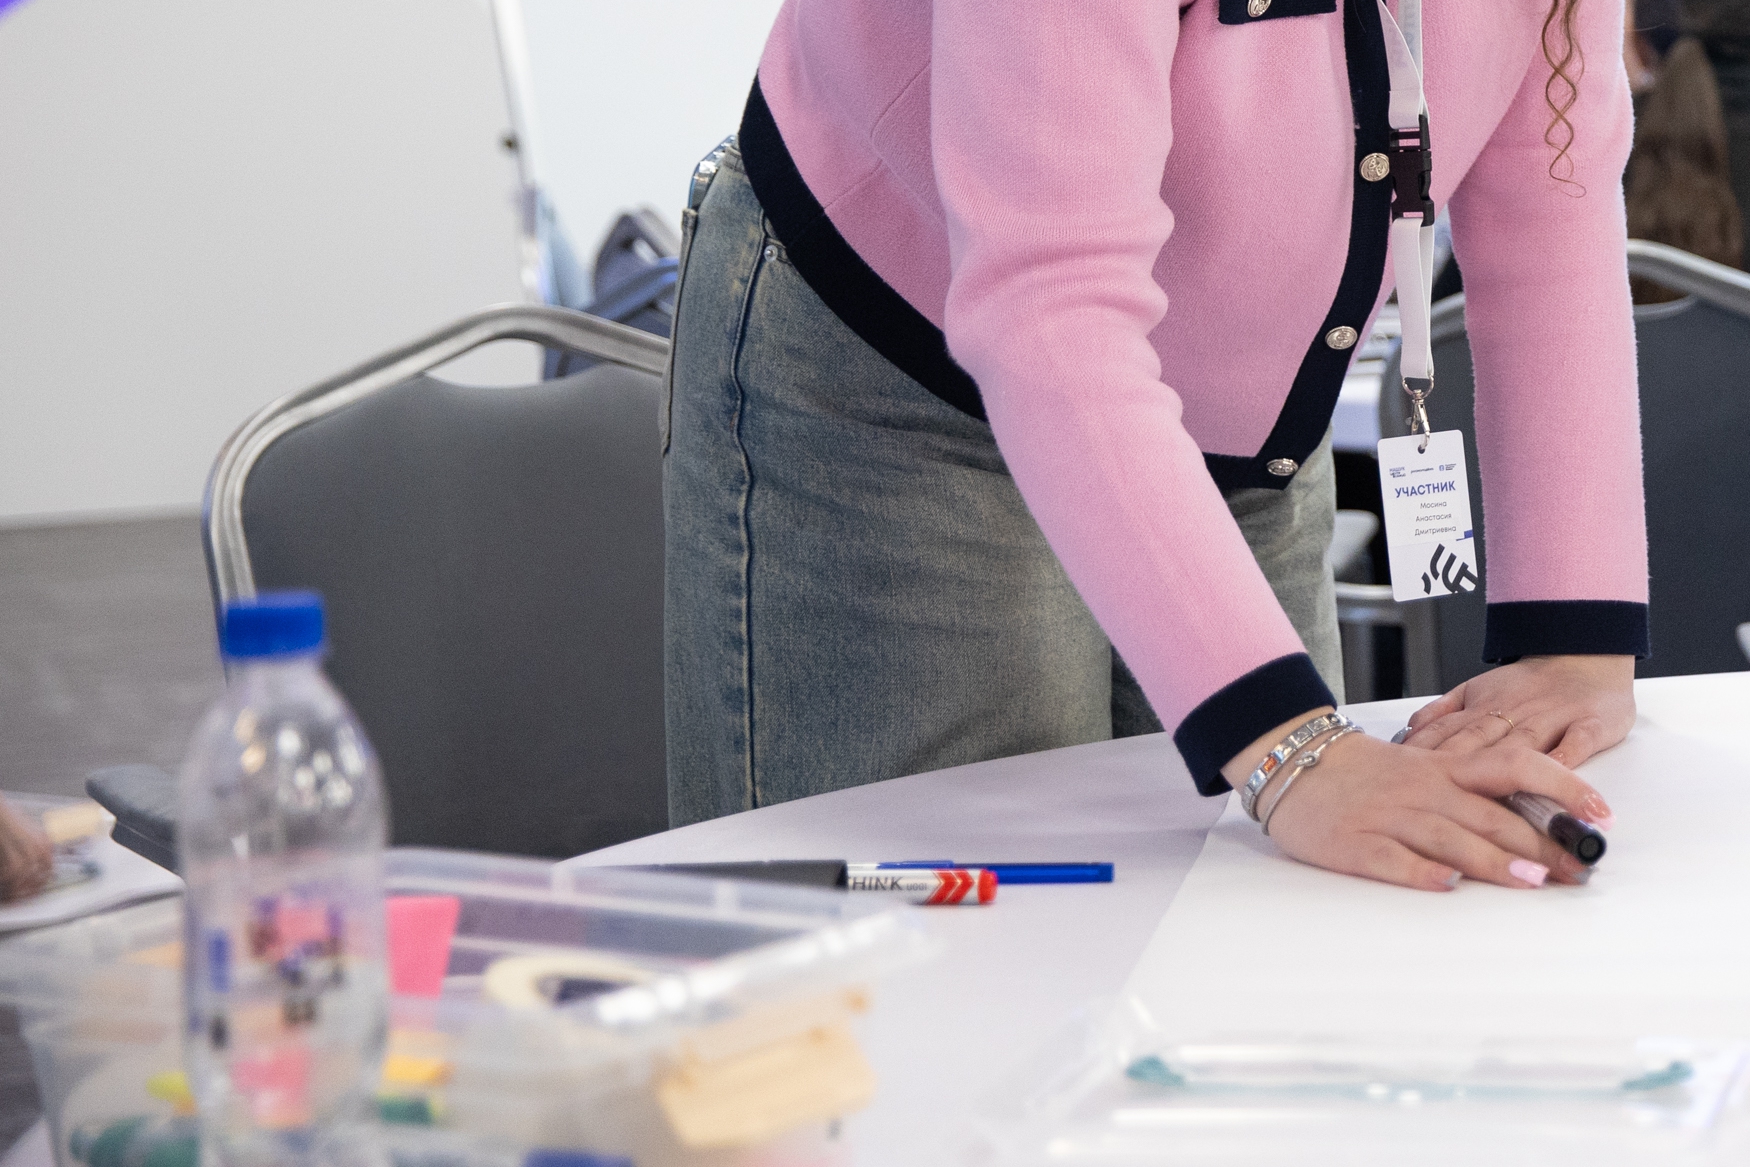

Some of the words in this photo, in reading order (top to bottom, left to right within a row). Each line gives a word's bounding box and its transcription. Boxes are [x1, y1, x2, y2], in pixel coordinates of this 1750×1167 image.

[1395, 480, 1456, 498] УЧАСТНИК
[1420, 501, 1447, 509] Мосина
[1416, 513, 1452, 522] Анастасия
[1415, 526, 1457, 536] Дмитриевна
[848, 876, 903, 891] HINK
